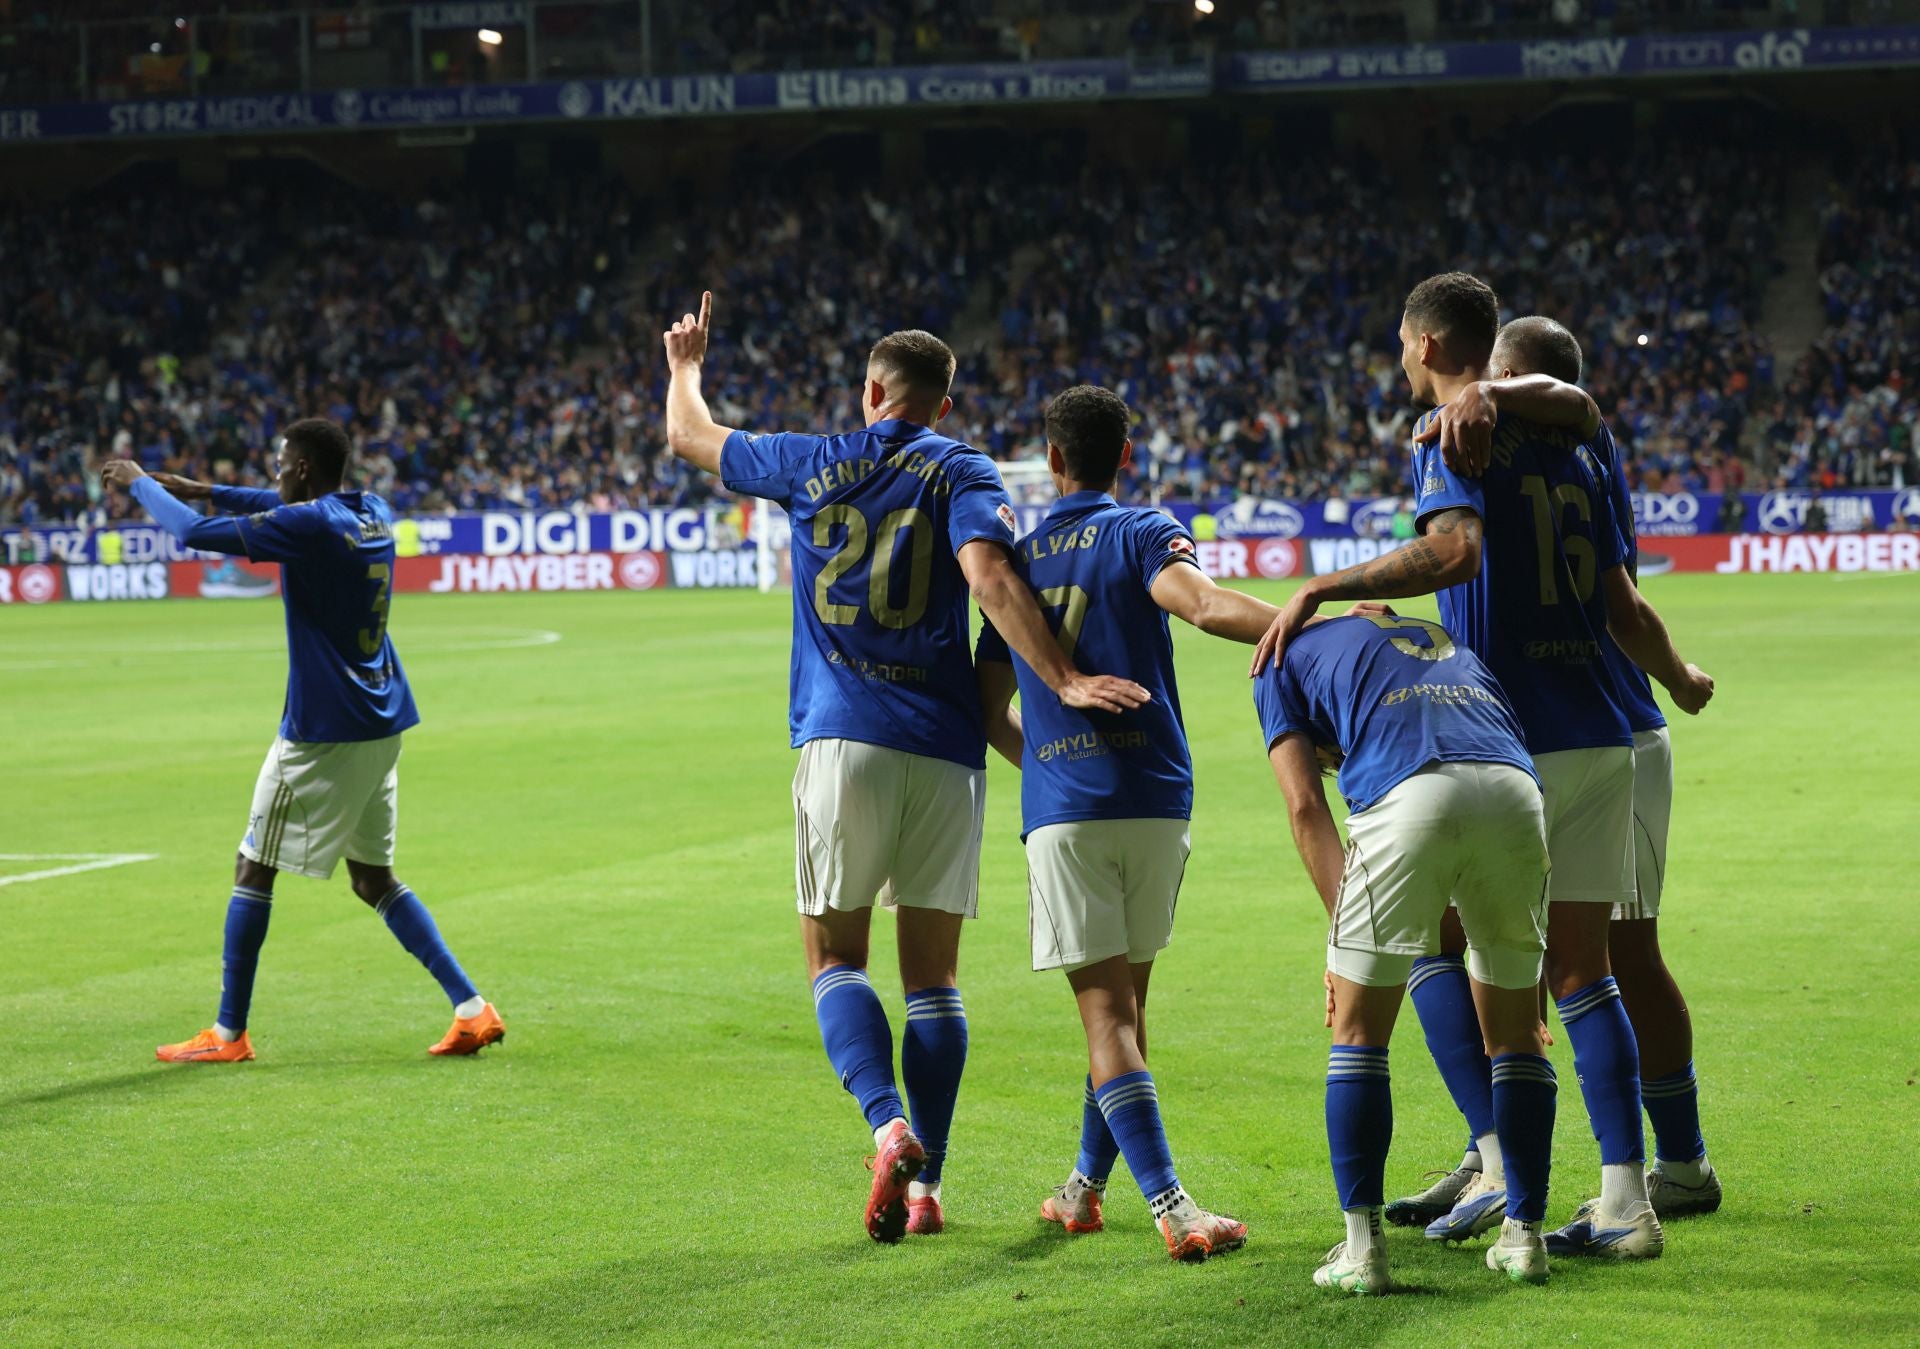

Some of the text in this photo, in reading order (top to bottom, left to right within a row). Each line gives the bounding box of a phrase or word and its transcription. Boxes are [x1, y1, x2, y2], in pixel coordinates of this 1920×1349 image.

[483, 510, 591, 556] DIGI
[813, 503, 934, 629] 20
[1520, 474, 1597, 606] 16
[67, 563, 168, 600] WORKS
[357, 563, 390, 655] 3
[1364, 615, 1456, 661] 5
